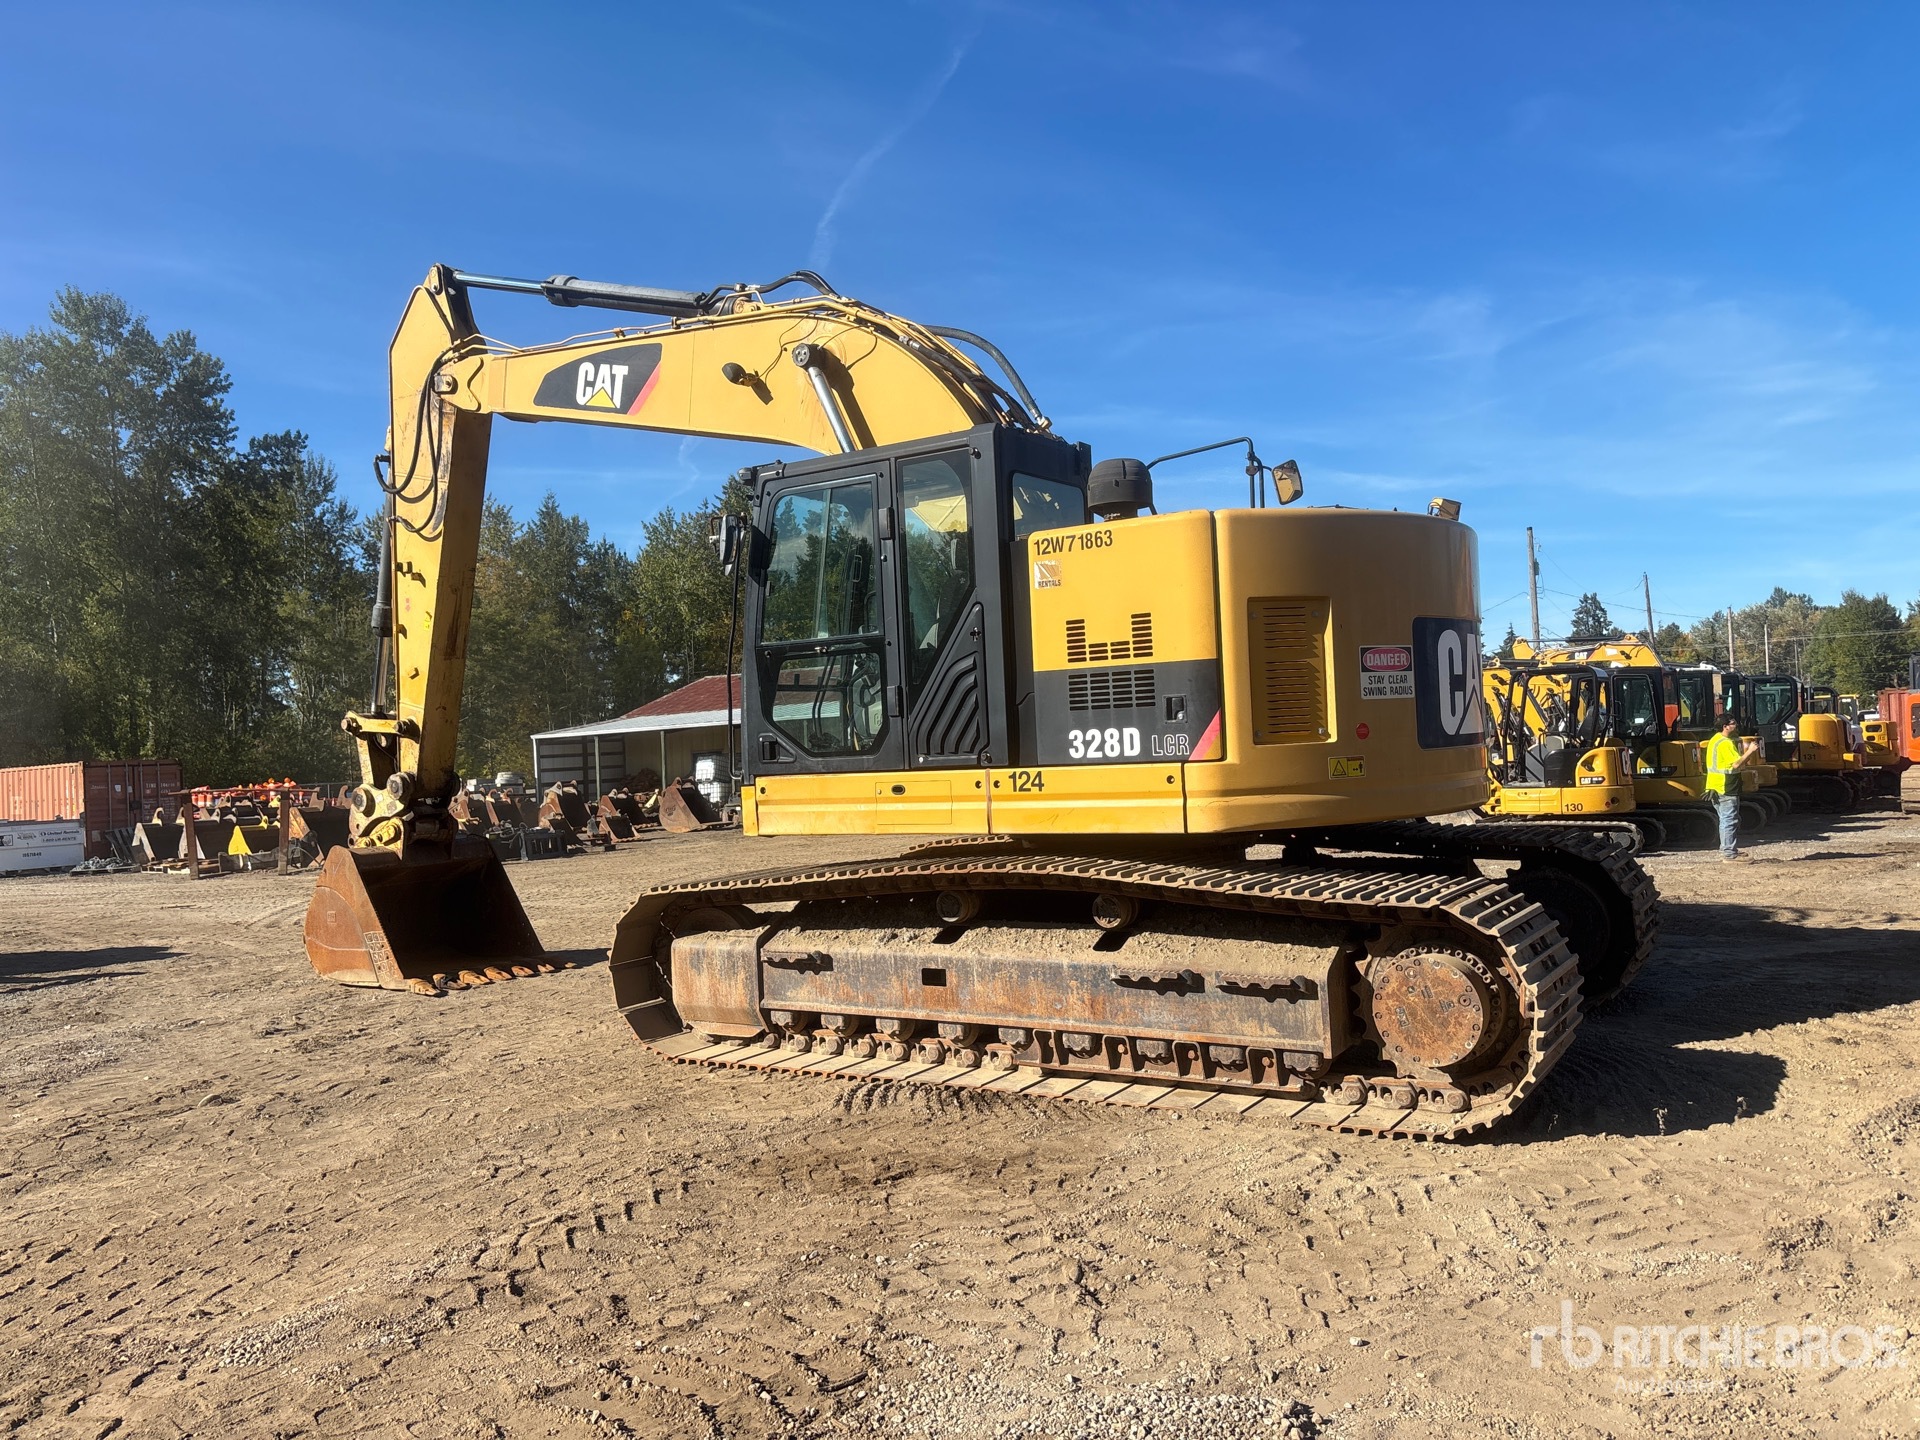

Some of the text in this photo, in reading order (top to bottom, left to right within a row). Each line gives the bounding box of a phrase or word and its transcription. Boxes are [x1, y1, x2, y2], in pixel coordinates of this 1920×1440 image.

[576, 361, 629, 409] CAT
[1033, 529, 1113, 556] 12W71863
[1366, 653, 1408, 666] DANGER
[1574, 651, 1588, 660] CAT
[1368, 675, 1408, 685] STAY CLEAR
[1438, 629, 1482, 736] CA
[1363, 686, 1413, 697] SWING RADIUS
[1781, 730, 1796, 739] CAT
[1068, 727, 1190, 759] 328D LCR
[1008, 771, 1044, 792] 124
[1564, 803, 1583, 812] 130
